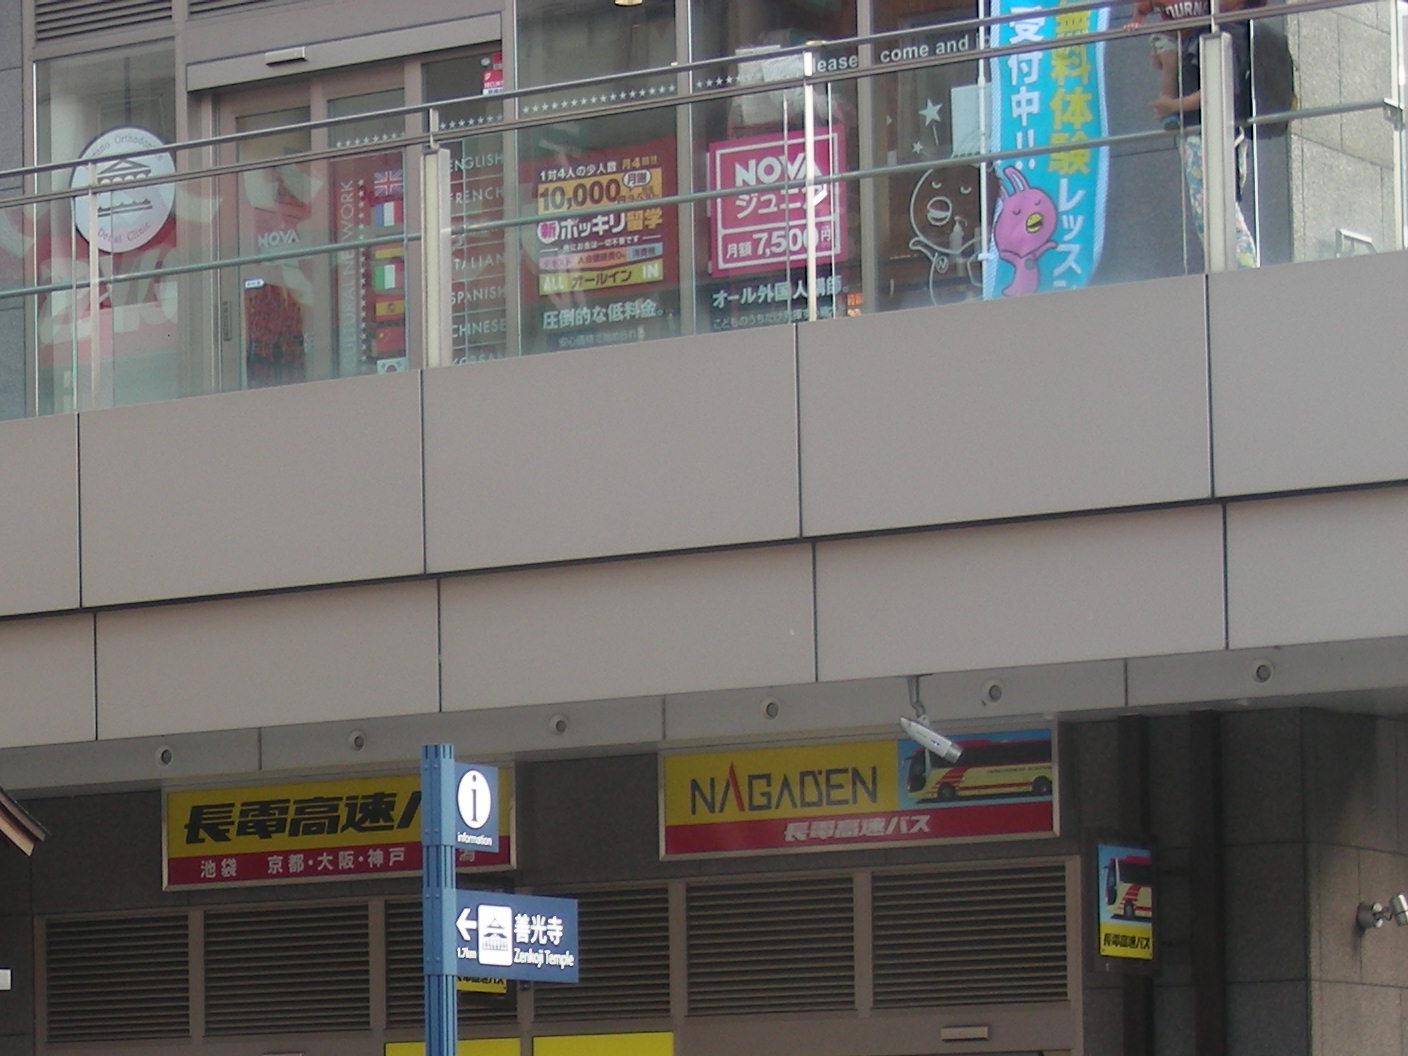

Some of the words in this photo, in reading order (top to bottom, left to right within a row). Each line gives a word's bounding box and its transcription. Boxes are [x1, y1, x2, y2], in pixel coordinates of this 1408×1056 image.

[813, 54, 858, 73] lease
[880, 42, 930, 64] come
[935, 36, 969, 56] and
[450, 154, 503, 172] ENGLISH
[735, 153, 823, 187] NOVA
[735, 183, 828, 219] ジュニア
[257, 229, 301, 248] NOVA
[340, 180, 356, 276] NEWORK
[453, 254, 505, 270] TALIAN
[726, 243, 752, 259] 月額
[571, 270, 633, 289] オールイン
[642, 263, 660, 279] IN
[450, 286, 506, 304] SPANISH
[543, 299, 664, 329] 圧倒的な低料金。
[451, 319, 506, 338] CHINESE
[690, 761, 878, 815] NAGADEN
[457, 832, 493, 847] information
[784, 814, 932, 842] 長電高速バス
[200, 858, 237, 879] 池袋
[267, 847, 405, 874] 京都・大阪・神戸
[513, 913, 564, 946] 善光寺
[513, 948, 544, 968] Zenkoji
[545, 951, 575, 969] Temple
